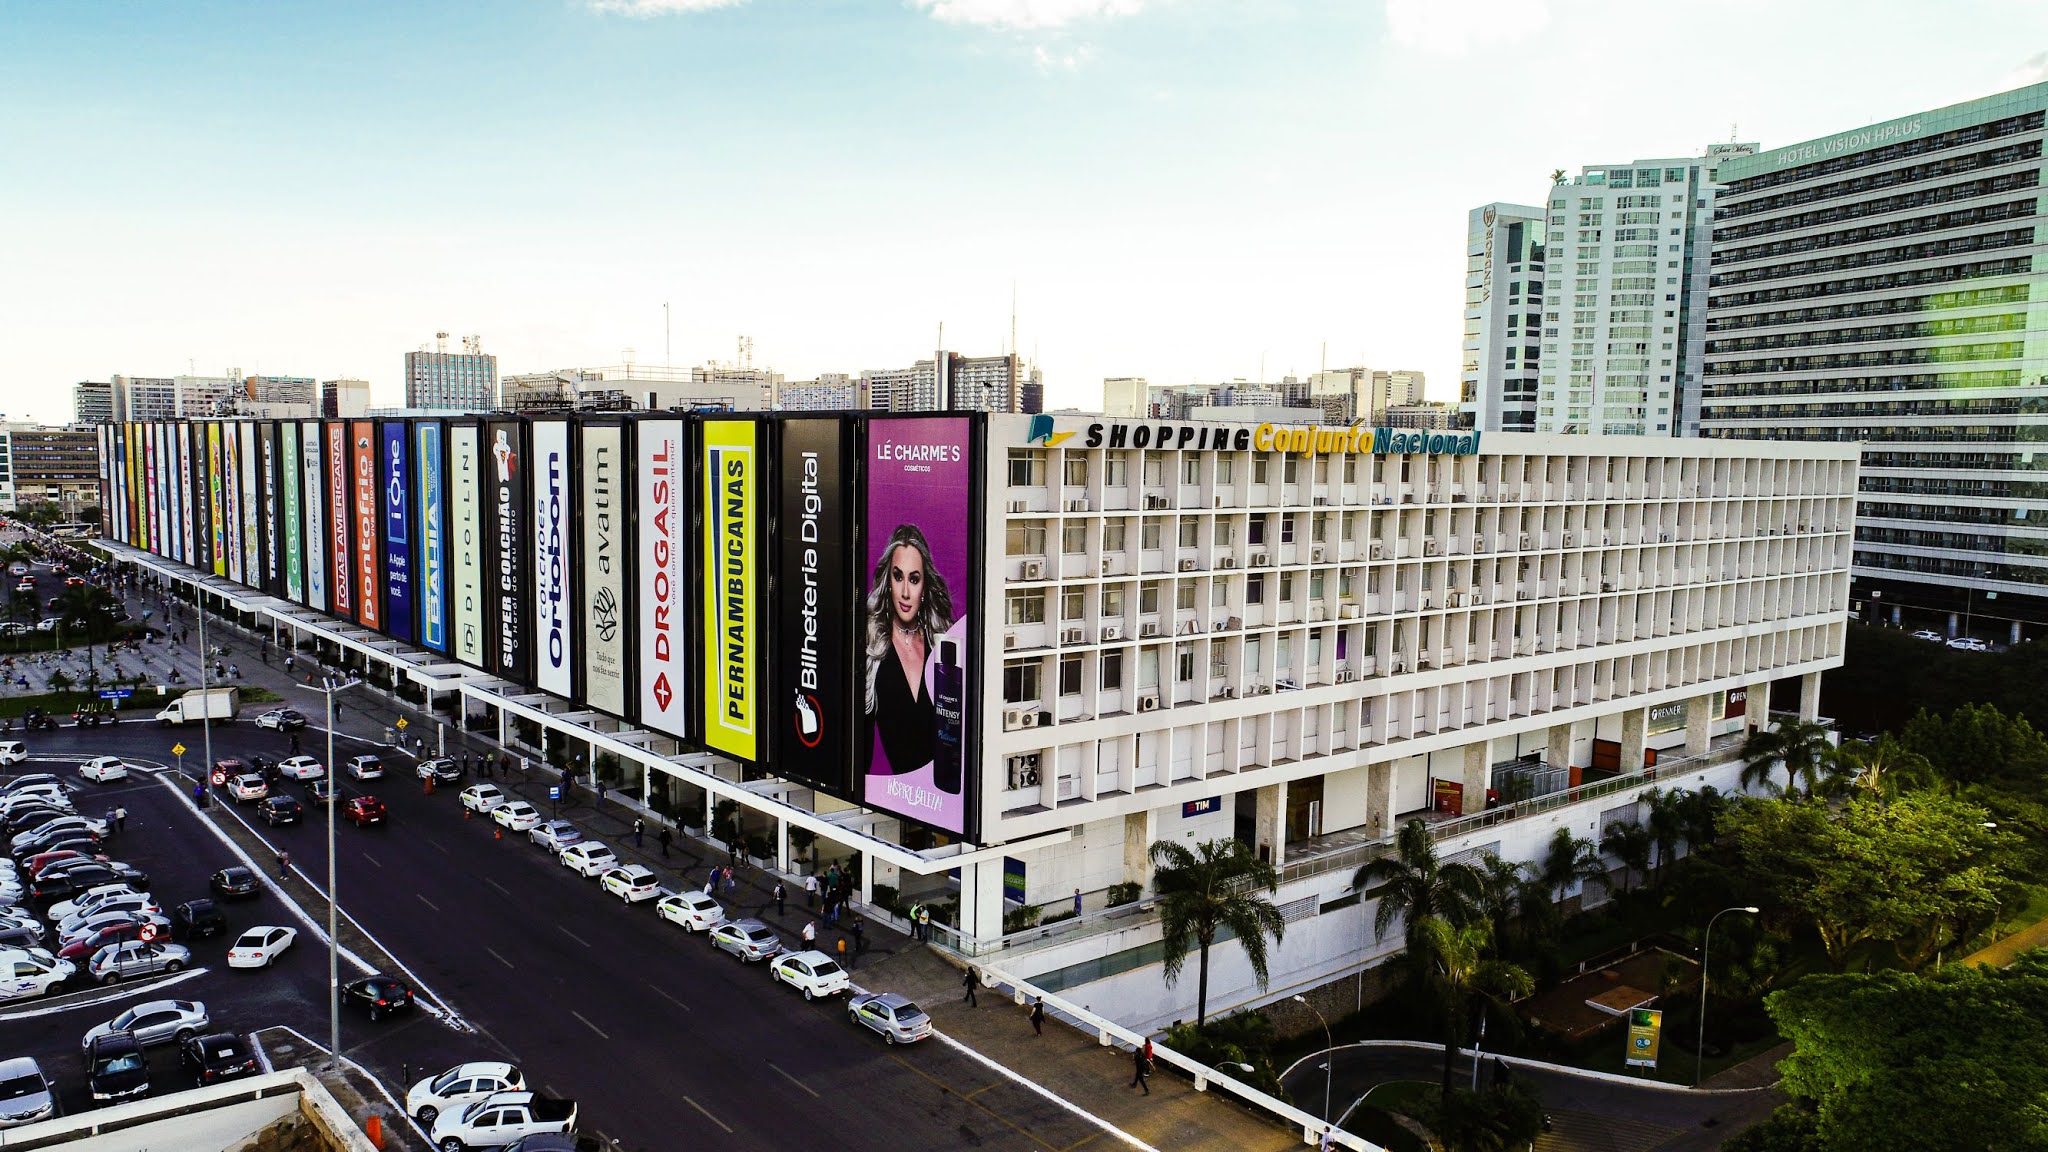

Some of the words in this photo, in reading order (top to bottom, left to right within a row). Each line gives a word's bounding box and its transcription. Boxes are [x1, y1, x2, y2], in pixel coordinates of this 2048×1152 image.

[1778, 144, 1818, 165] HOTEL
[1824, 131, 1870, 154] VISION
[1874, 120, 1922, 142] HPLUS
[1483, 228, 1494, 302] WINDSOR
[264, 438, 272, 495] FIELD
[389, 439, 402, 506] One
[878, 439, 892, 460] LÉ
[894, 444, 960, 462] CHARME'S
[904, 464, 931, 472] COSMÉTICOS
[1085, 423, 1250, 451] SHOPPING
[1254, 422, 1374, 459] Conjunto
[1373, 427, 1482, 456] Nacional
[197, 433, 208, 563] RIACHUELO
[287, 437, 298, 554] Boticário
[333, 428, 345, 546] AMERICANAS
[391, 512, 402, 520] i
[462, 442, 472, 566] POLLINI
[594, 446, 610, 575] avatim
[802, 451, 822, 544] Digital
[268, 516, 277, 580] TRACK
[359, 455, 375, 622] pontofrio
[428, 502, 440, 625] BAHIA
[498, 486, 511, 590] COLCHÃO
[549, 452, 562, 668] Ortobom
[653, 440, 670, 662] DROGASIL
[670, 522, 676, 539] em
[338, 551, 347, 608] LOJAS
[466, 583, 472, 612] DI
[511, 576, 517, 592] do
[728, 459, 745, 720] PERNAMBUCANAS
[502, 596, 513, 668] SUPER
[802, 548, 818, 691] Bilheteria
[936, 707, 960, 720] INTENSY
[1658, 705, 1680, 718] RENNER
[1195, 800, 1210, 811] TIM
